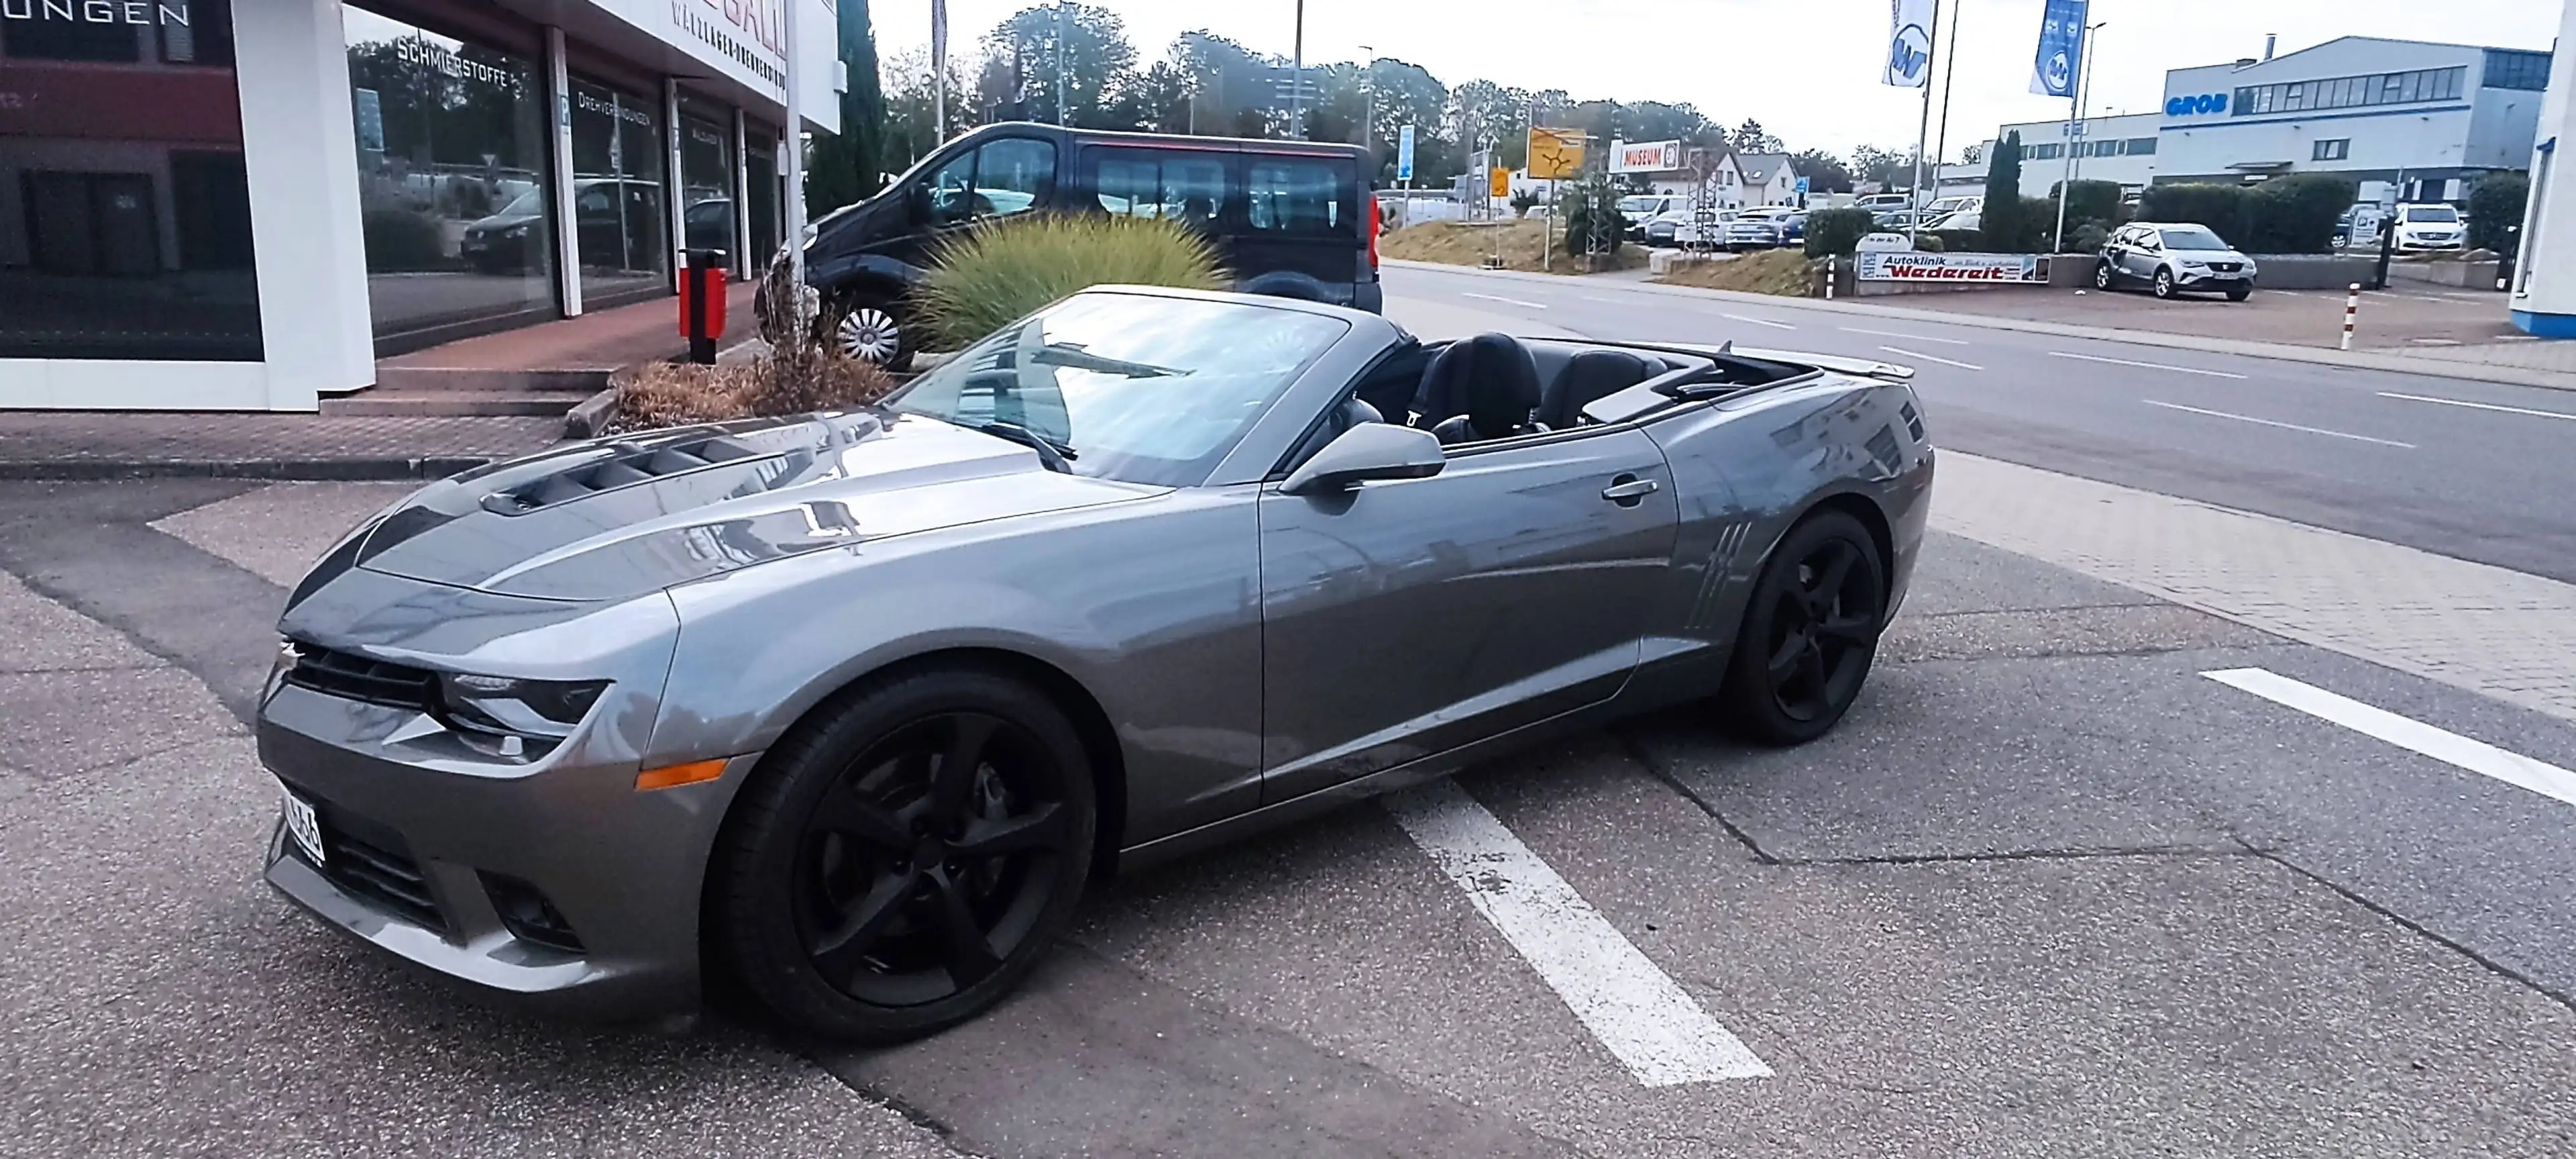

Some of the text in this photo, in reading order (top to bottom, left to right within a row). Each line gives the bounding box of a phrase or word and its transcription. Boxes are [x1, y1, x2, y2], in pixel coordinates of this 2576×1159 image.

[396, 37, 508, 87] SCHMIERSTOFFE
[2166, 93, 2229, 117] GROB
[1623, 147, 1662, 166] MUSEUM
[1884, 255, 1947, 266] Autoklinik
[1887, 266, 2004, 279] Wedereit
